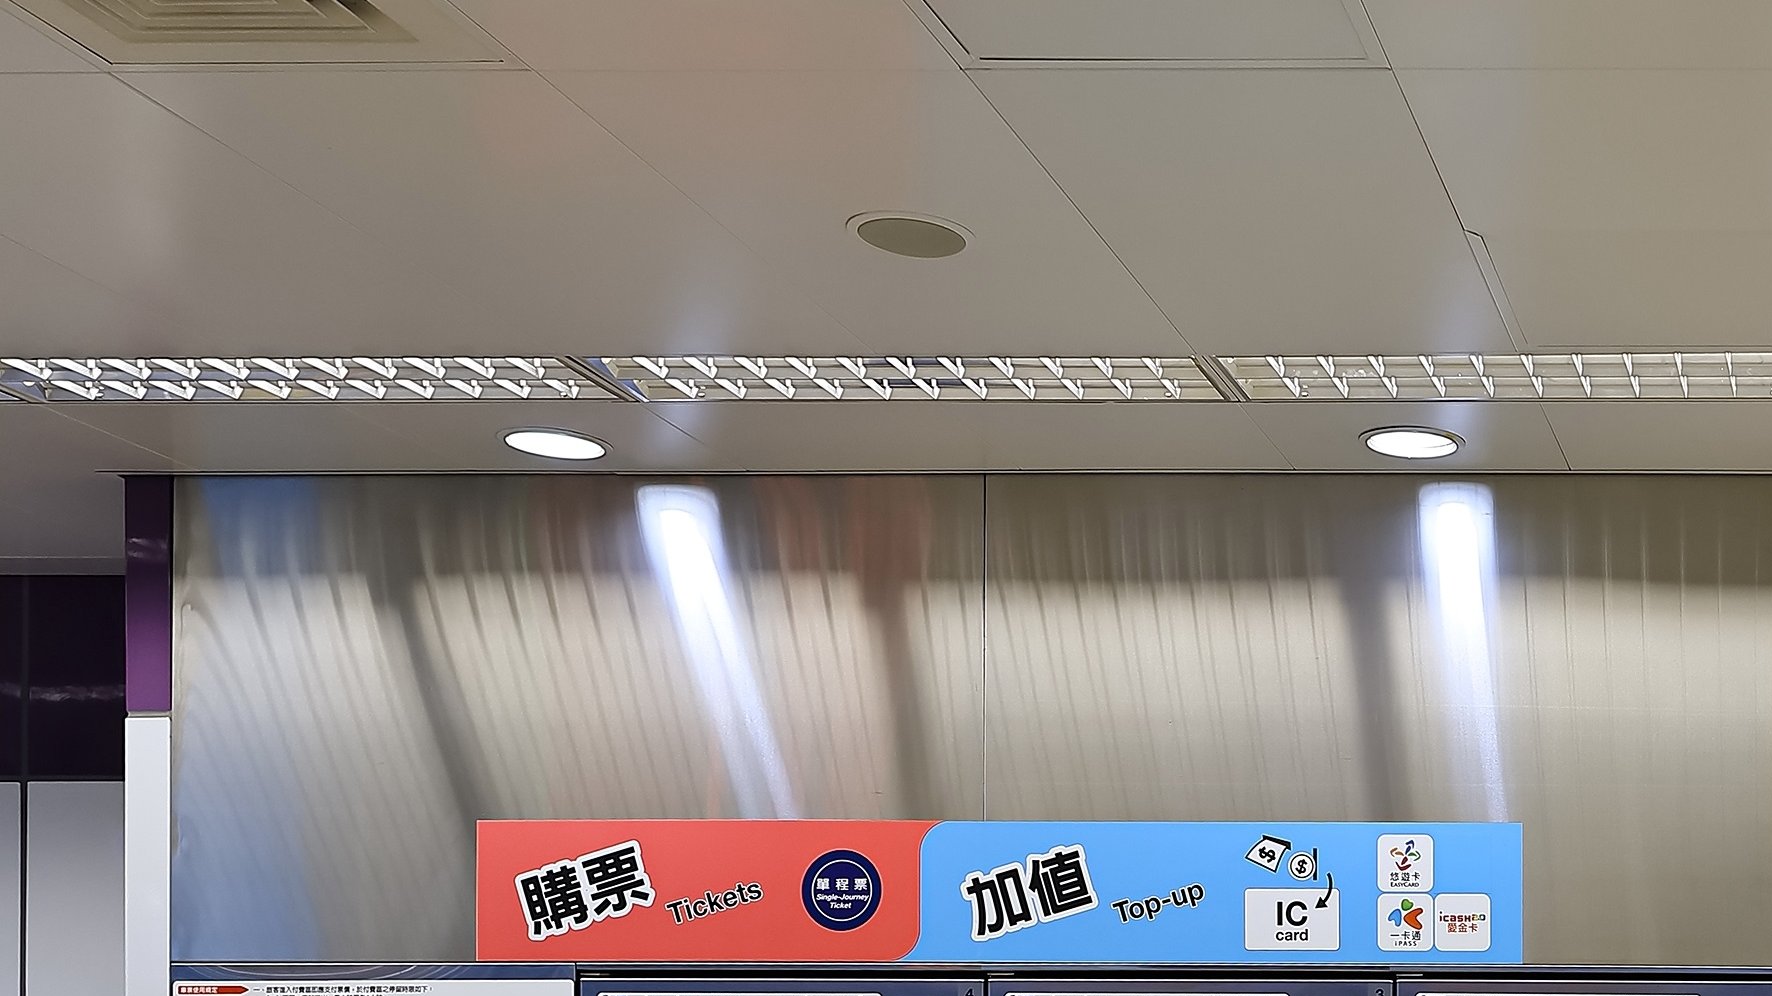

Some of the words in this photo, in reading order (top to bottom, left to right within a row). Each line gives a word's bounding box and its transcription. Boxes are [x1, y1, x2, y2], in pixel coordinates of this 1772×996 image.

[1390, 872, 1420, 882] 悠遊卡
[521, 846, 650, 935] 購票
[816, 877, 867, 892] 單程票
[816, 893, 869, 902] Single-Journey
[966, 850, 1092, 936] 加值
[666, 883, 763, 924] Tickets
[829, 901, 852, 910] Ticket
[1112, 883, 1204, 922] Top-up
[1276, 901, 1307, 927] IC
[1276, 928, 1308, 941] card
[1447, 923, 1478, 933] 愛金卡
[1390, 931, 1421, 940] 一卡通
